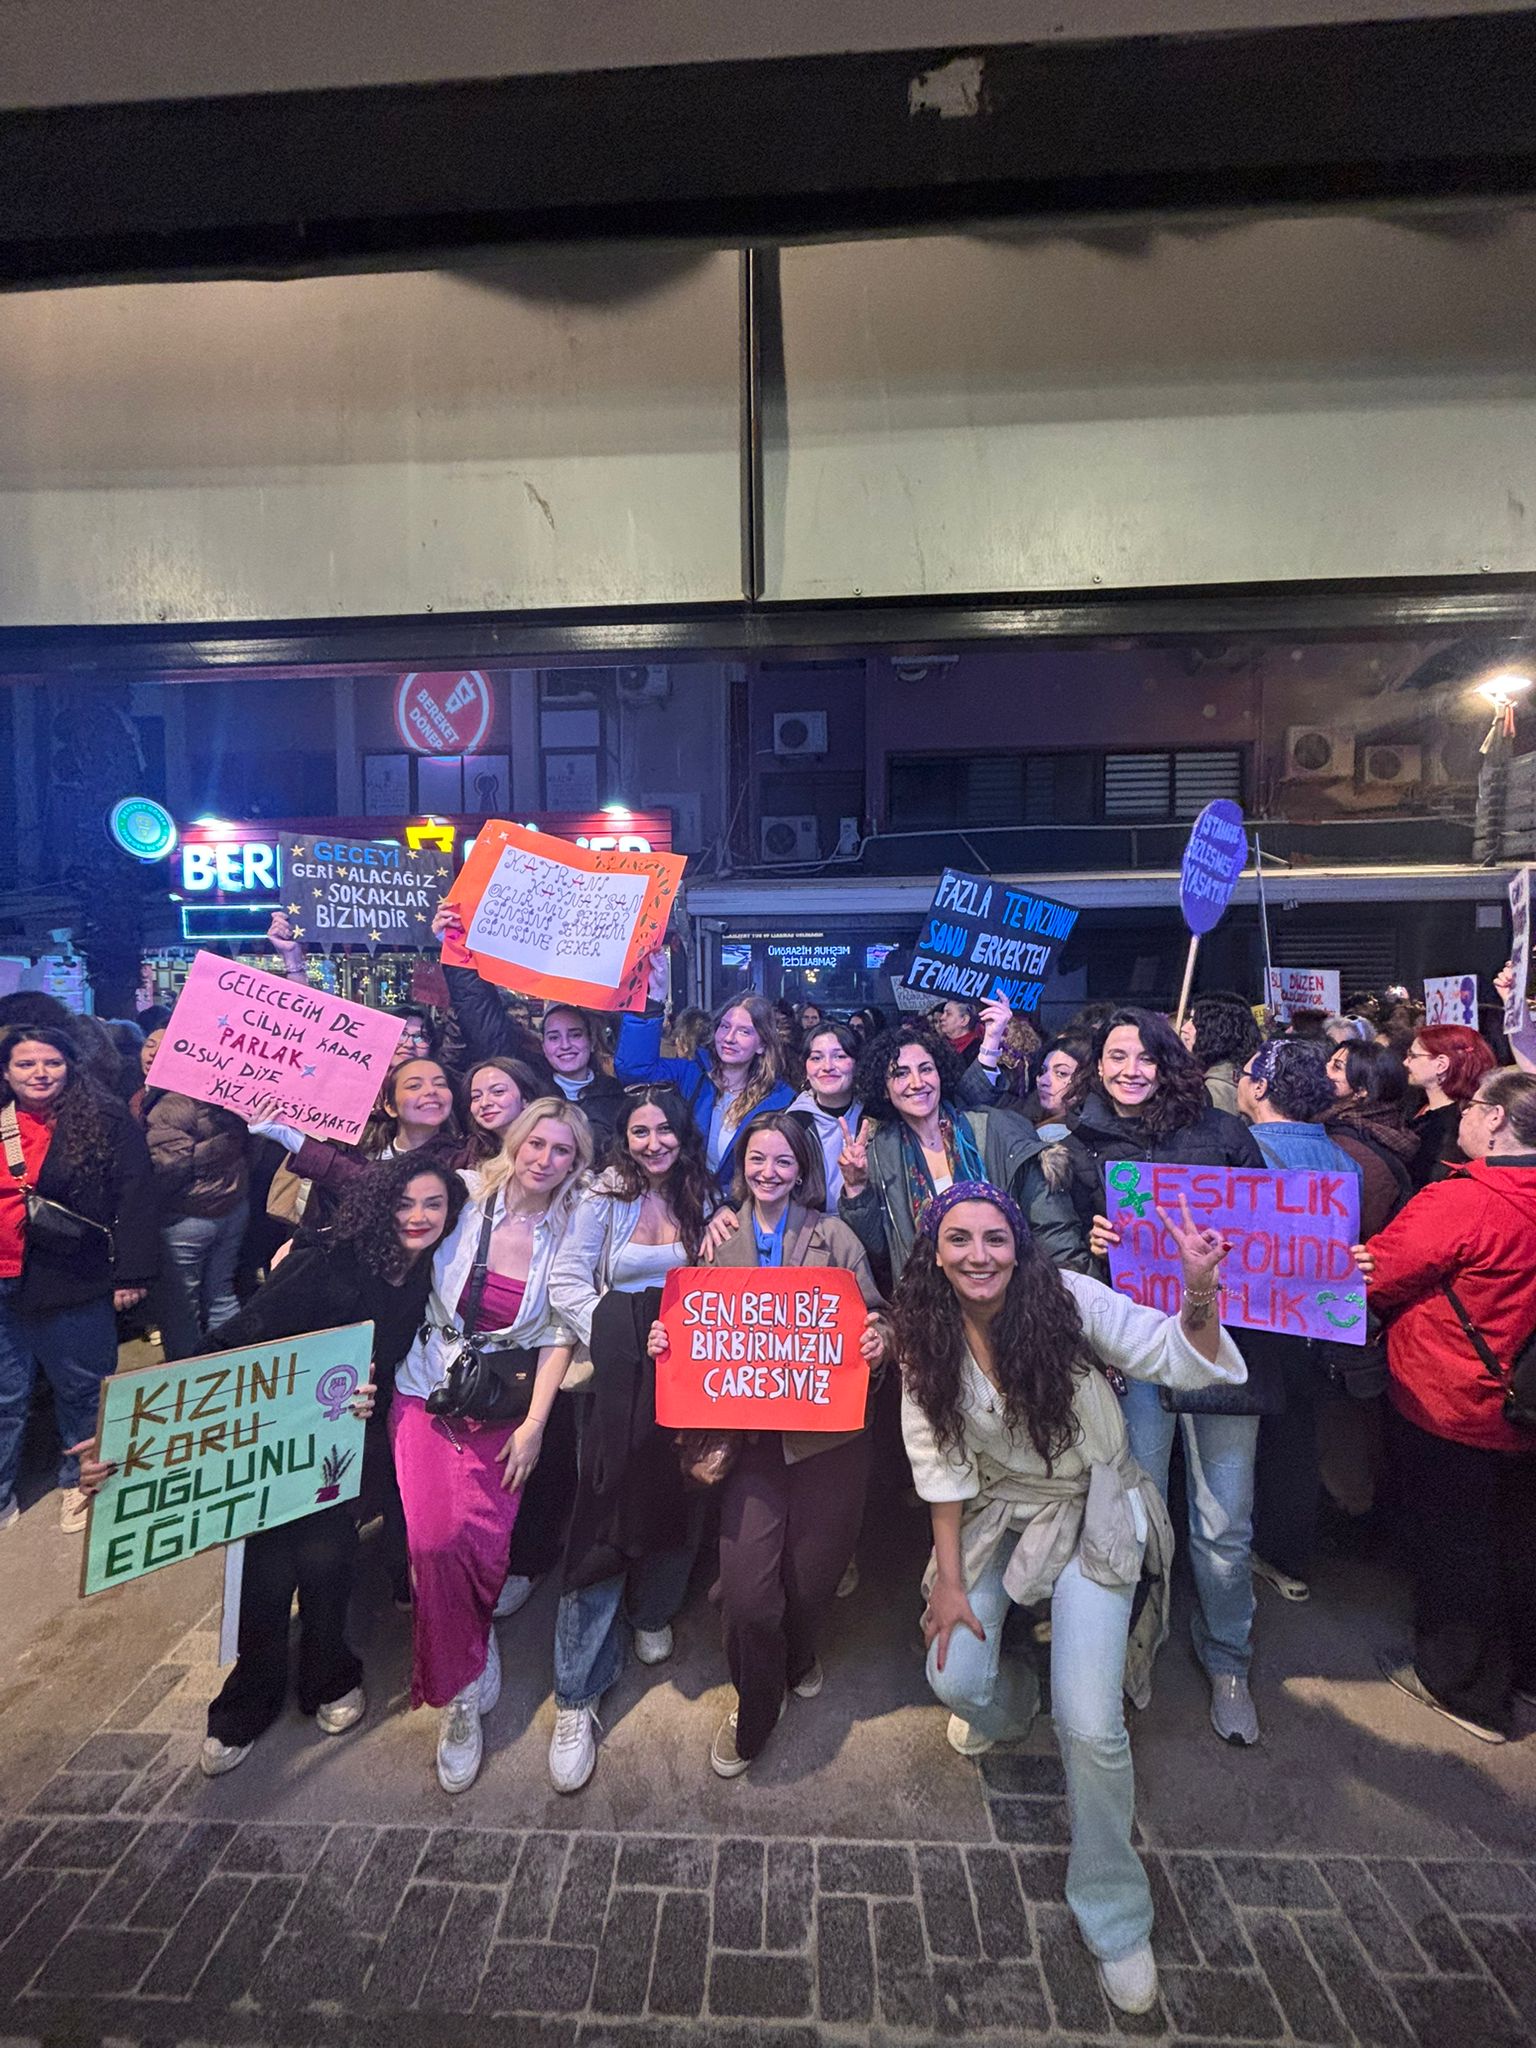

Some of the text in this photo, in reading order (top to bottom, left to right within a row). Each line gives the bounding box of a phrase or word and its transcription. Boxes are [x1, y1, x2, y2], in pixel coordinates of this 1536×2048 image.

[417, 688, 459, 743] BEREKET
[292, 863, 437, 889] GERİ ALACAĞIZ
[313, 842, 400, 867] GECEYİ
[316, 903, 409, 929] BİZİMDİR
[328, 883, 430, 907] SOKAKLAR
[488, 883, 533, 908] OLUR
[537, 901, 571, 920] MU
[527, 878, 644, 914] KAYNATSAN
[935, 873, 993, 919] FAZLA
[919, 919, 1051, 976] SONU ERKEKTEN
[218, 970, 364, 1038] GELECEĞİM DE
[173, 1039, 283, 1084] OLSUN DİYE
[219, 1027, 304, 1068] PARLAK
[243, 1009, 372, 1071] CİLDİM KADAR
[208, 1078, 244, 1102] KIZ
[302, 1106, 361, 1135] SOKAKTA
[1151, 1167, 1348, 1217] EŞİTLİK
[795, 1286, 841, 1328] BİZ
[690, 1325, 844, 1366] BİRBİRİMİZİN
[130, 1352, 298, 1438] KIZINI
[123, 1412, 260, 1477] KORU
[114, 1434, 315, 1524] OĞLUNU
[105, 1486, 270, 1578] EĞİT!
